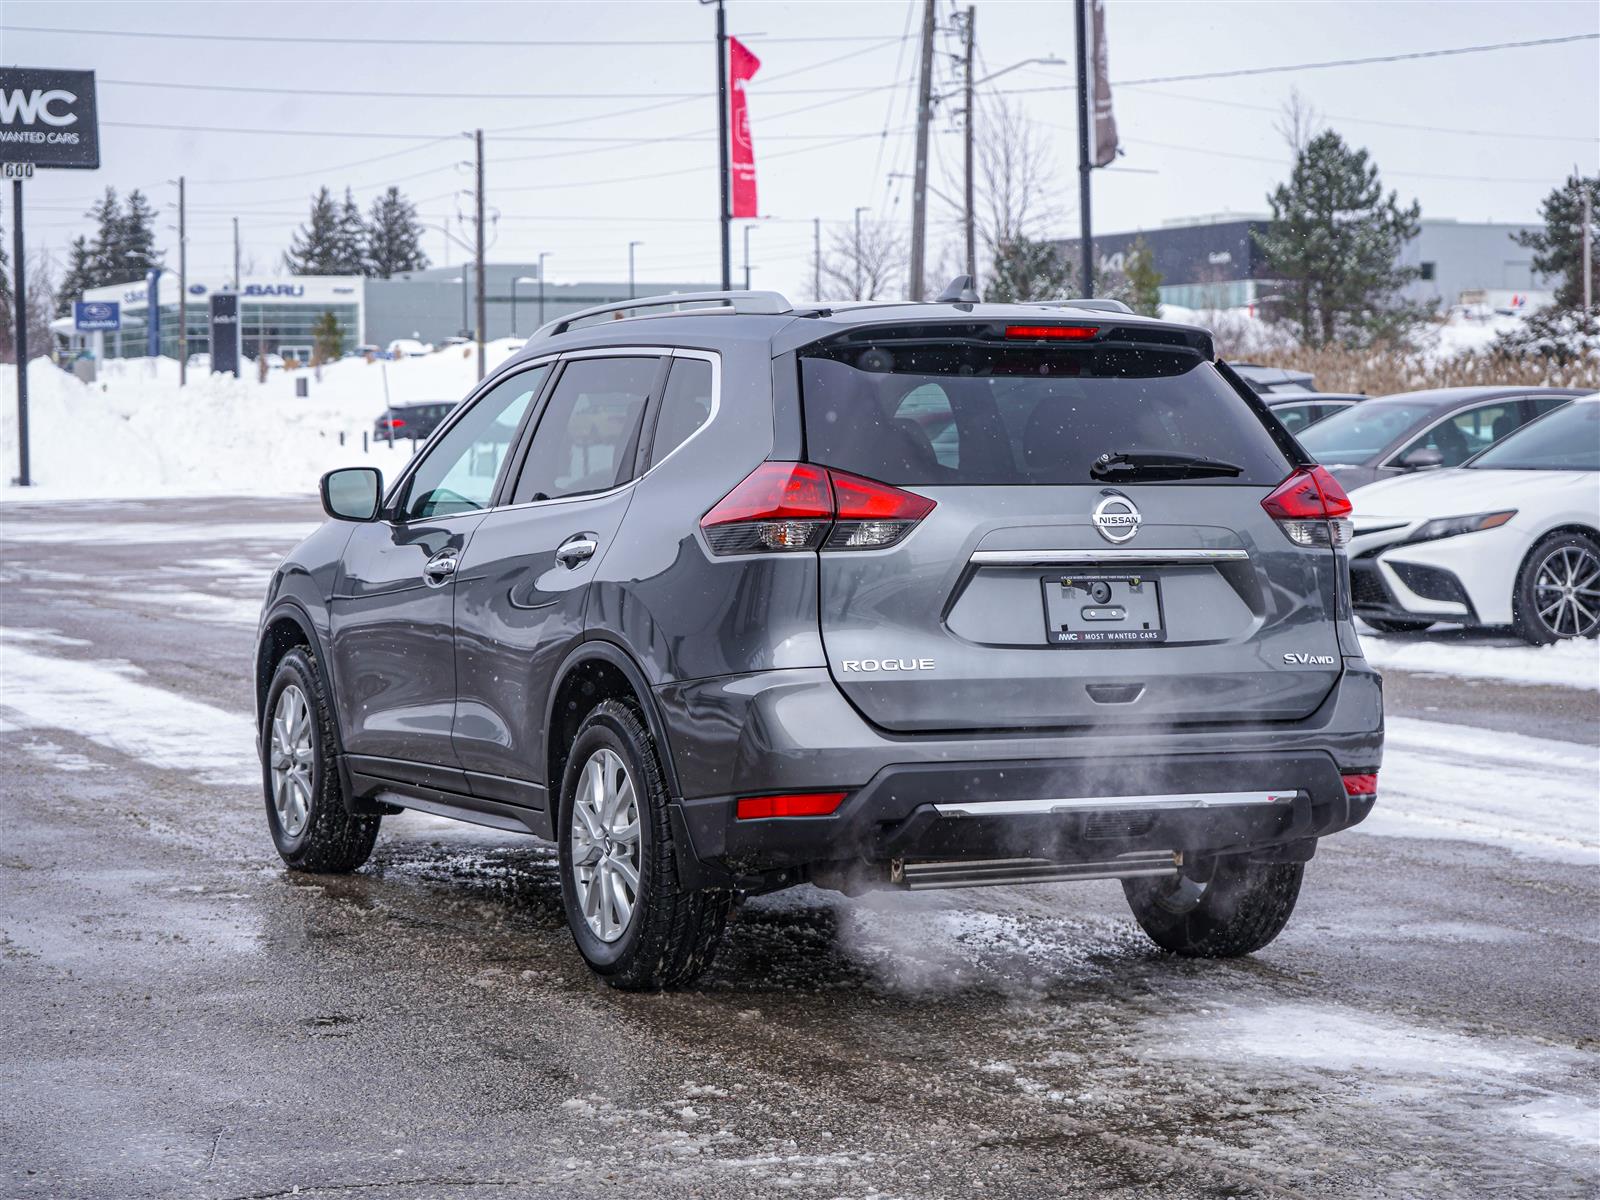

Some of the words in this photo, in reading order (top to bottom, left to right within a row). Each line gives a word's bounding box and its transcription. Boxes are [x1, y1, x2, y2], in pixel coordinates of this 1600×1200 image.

[47, 132, 80, 145] CARS
[1099, 516, 1138, 524] NISSAN
[1107, 632, 1138, 640] WANTED
[842, 658, 936, 672] ROGUE
